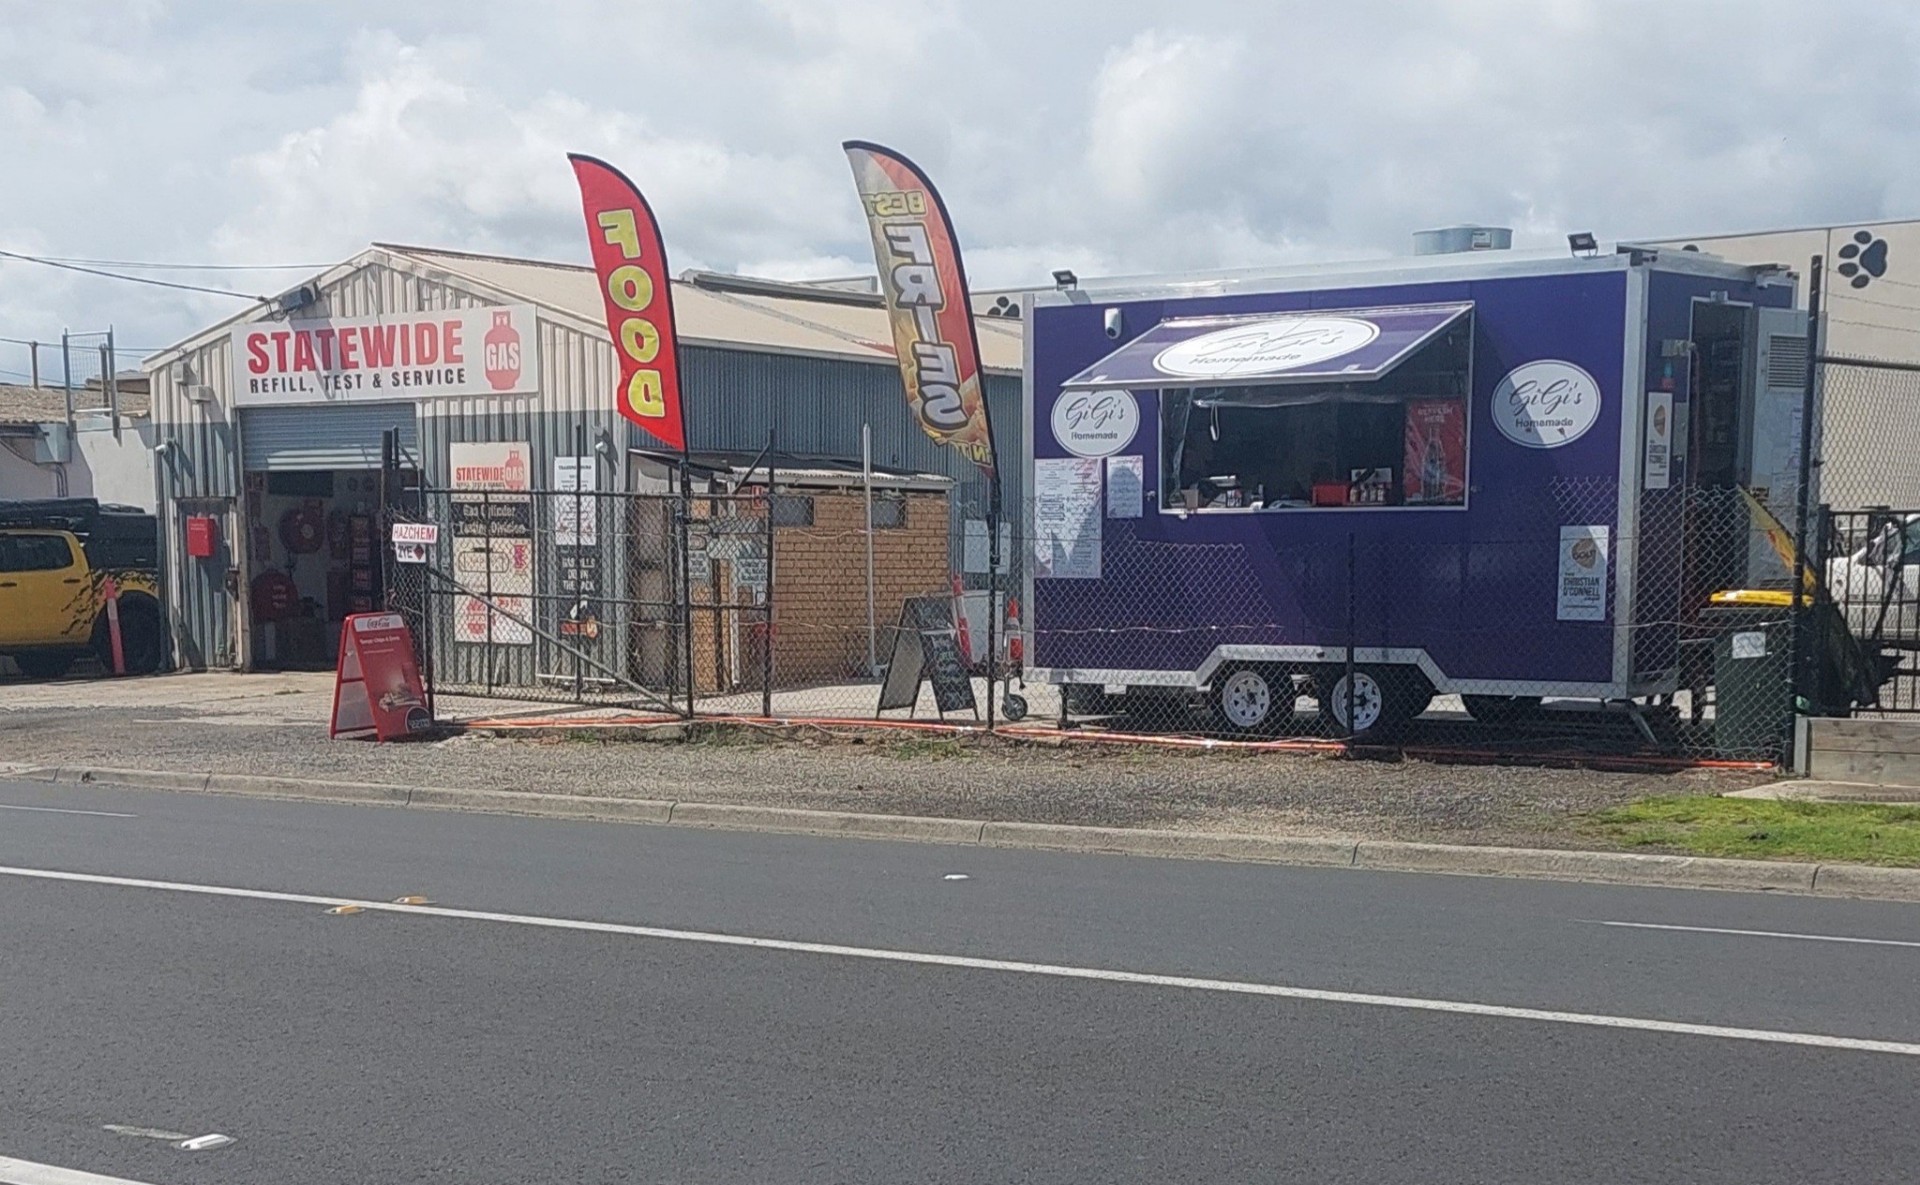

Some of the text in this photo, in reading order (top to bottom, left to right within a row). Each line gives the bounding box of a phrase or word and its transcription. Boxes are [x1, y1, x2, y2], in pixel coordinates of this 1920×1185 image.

[247, 320, 464, 374] STATEWIDE
[485, 342, 519, 371] GAS
[1188, 353, 1302, 365] Homemade
[250, 368, 466, 393] REFILL, TEST & SERVICE
[1508, 379, 1582, 416] GiGi's
[1065, 396, 1124, 430] GiGi's
[1515, 417, 1573, 428] Homemade
[1071, 430, 1118, 440] Homemade
[456, 467, 504, 481] STATEWIDE
[505, 466, 523, 481] GAS
[393, 525, 435, 540] HAZCHEM
